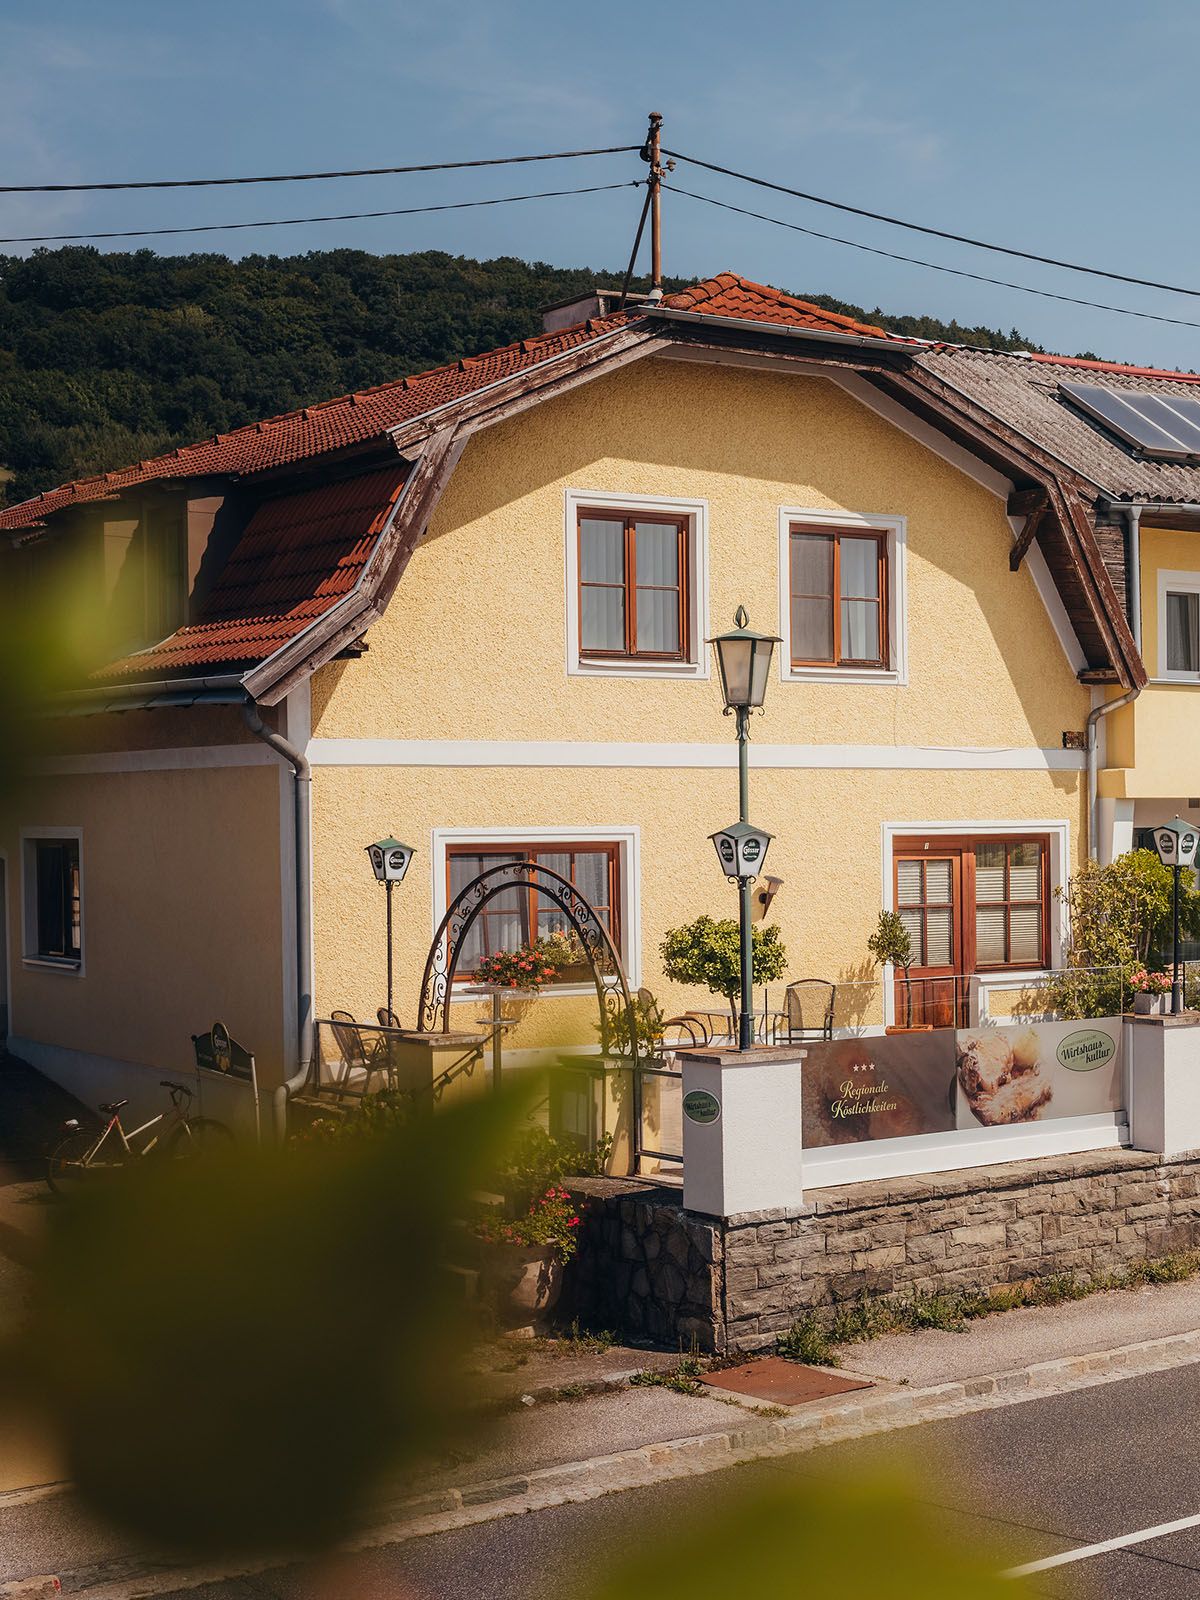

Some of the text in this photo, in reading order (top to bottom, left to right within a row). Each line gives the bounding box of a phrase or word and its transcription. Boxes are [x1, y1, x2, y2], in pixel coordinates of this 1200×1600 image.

[1085, 1048, 1111, 1064] kultur
[839, 1080, 889, 1100] Regionale
[831, 1099, 897, 1119] Köstlichkeiten
